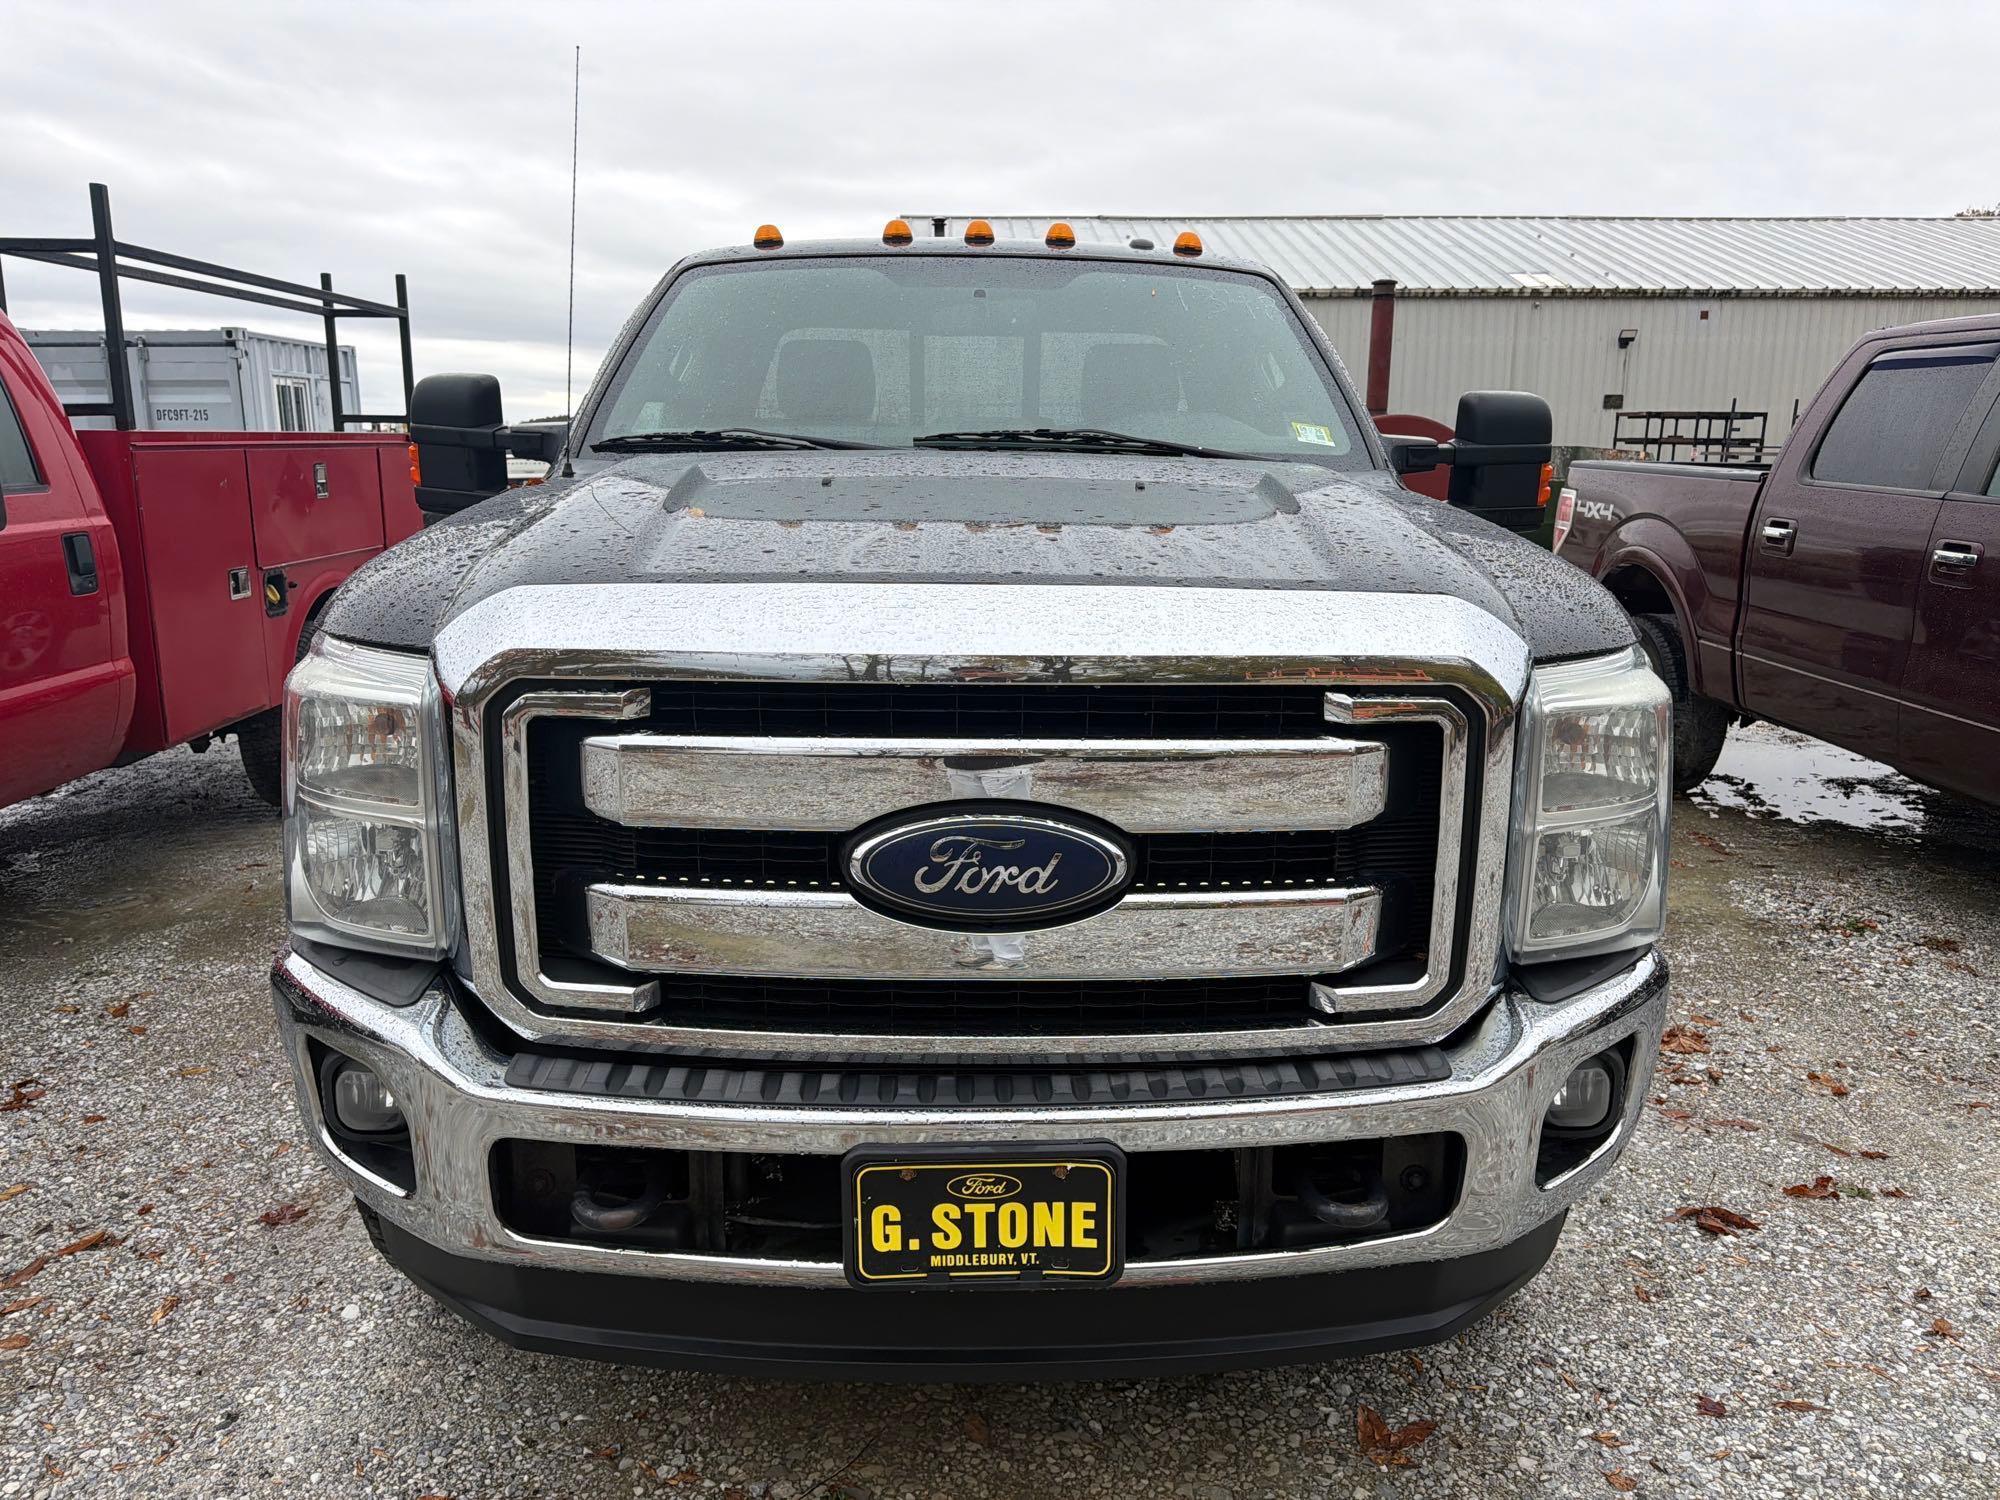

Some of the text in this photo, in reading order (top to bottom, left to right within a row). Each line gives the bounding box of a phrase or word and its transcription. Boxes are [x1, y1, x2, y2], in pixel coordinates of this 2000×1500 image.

[156, 408, 209, 421] DFC9FT-215
[914, 836, 1062, 894] Ford
[962, 1177, 1006, 1195] Ford
[871, 1201, 1098, 1253] G. STONE
[930, 1252, 1040, 1268] MIDDLEBURY, VT.
